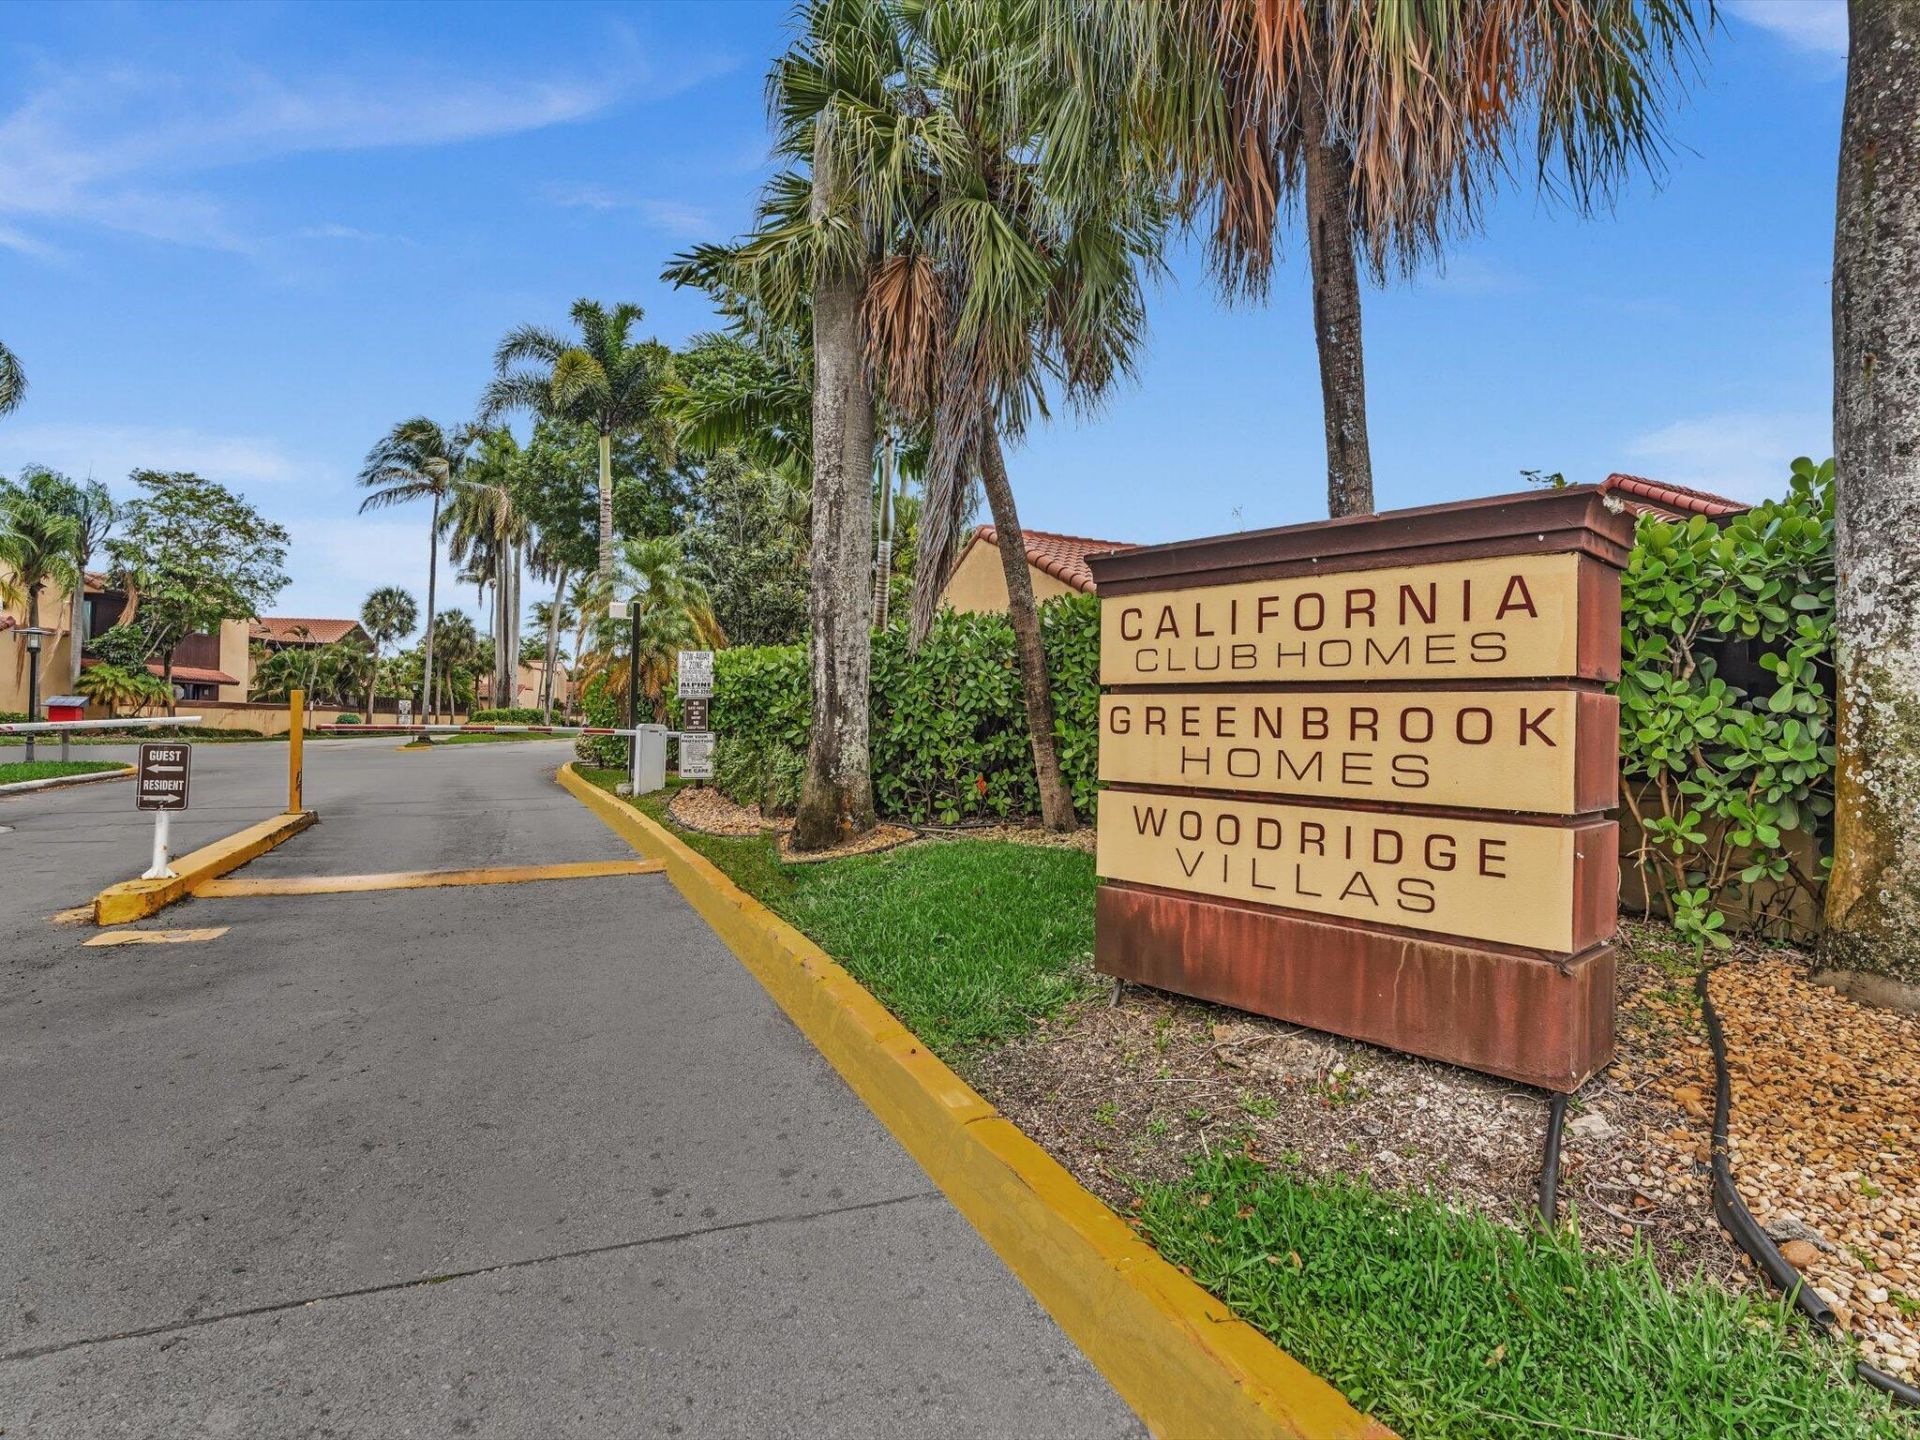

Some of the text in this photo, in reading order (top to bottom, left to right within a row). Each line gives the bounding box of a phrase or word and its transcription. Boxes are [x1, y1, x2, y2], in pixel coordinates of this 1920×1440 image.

[1120, 574, 1538, 642] CALIFORNIA
[1135, 632, 1508, 673] CLUB HOMES
[1109, 705, 1557, 748] GREENBROOK
[149, 750, 181, 761] GUEST
[1180, 745, 1430, 789] HOMES
[143, 780, 184, 790] RESIDENT
[1133, 804, 1508, 879] WOODRIDGE
[1175, 846, 1436, 914] VILLAS
